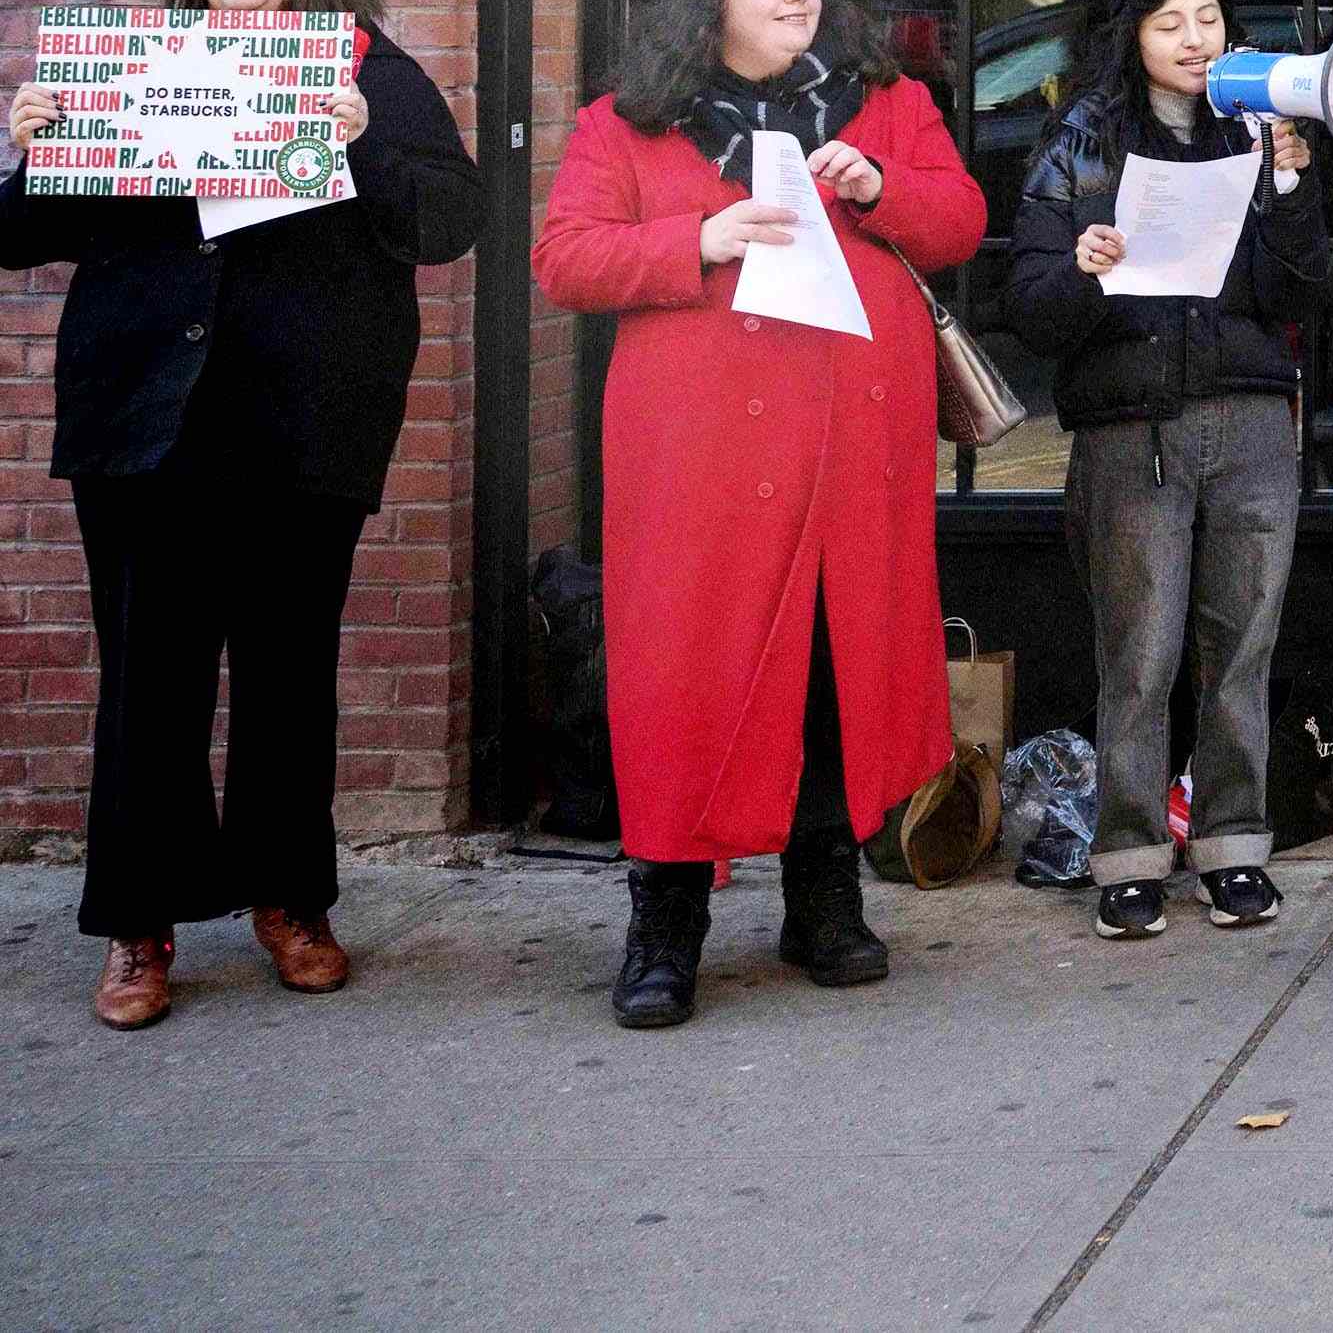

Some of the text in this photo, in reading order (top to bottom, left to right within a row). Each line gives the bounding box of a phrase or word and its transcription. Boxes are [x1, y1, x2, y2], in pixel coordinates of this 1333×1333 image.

[41, 7, 126, 27] EBELLION
[131, 8, 165, 28] RED
[208, 10, 302, 30] REBELLION
[305, 11, 338, 31] RED
[39, 33, 125, 55] EBELLION
[303, 37, 337, 59] RED
[36, 61, 122, 83] EBELLION
[302, 65, 335, 87] RED
[145, 87, 235, 102] DO BETTER,
[140, 104, 238, 117] STARBUCKS!
[28, 146, 116, 168] EBELLION
[27, 175, 114, 196] EBELLION
[117, 177, 152, 196] RED
